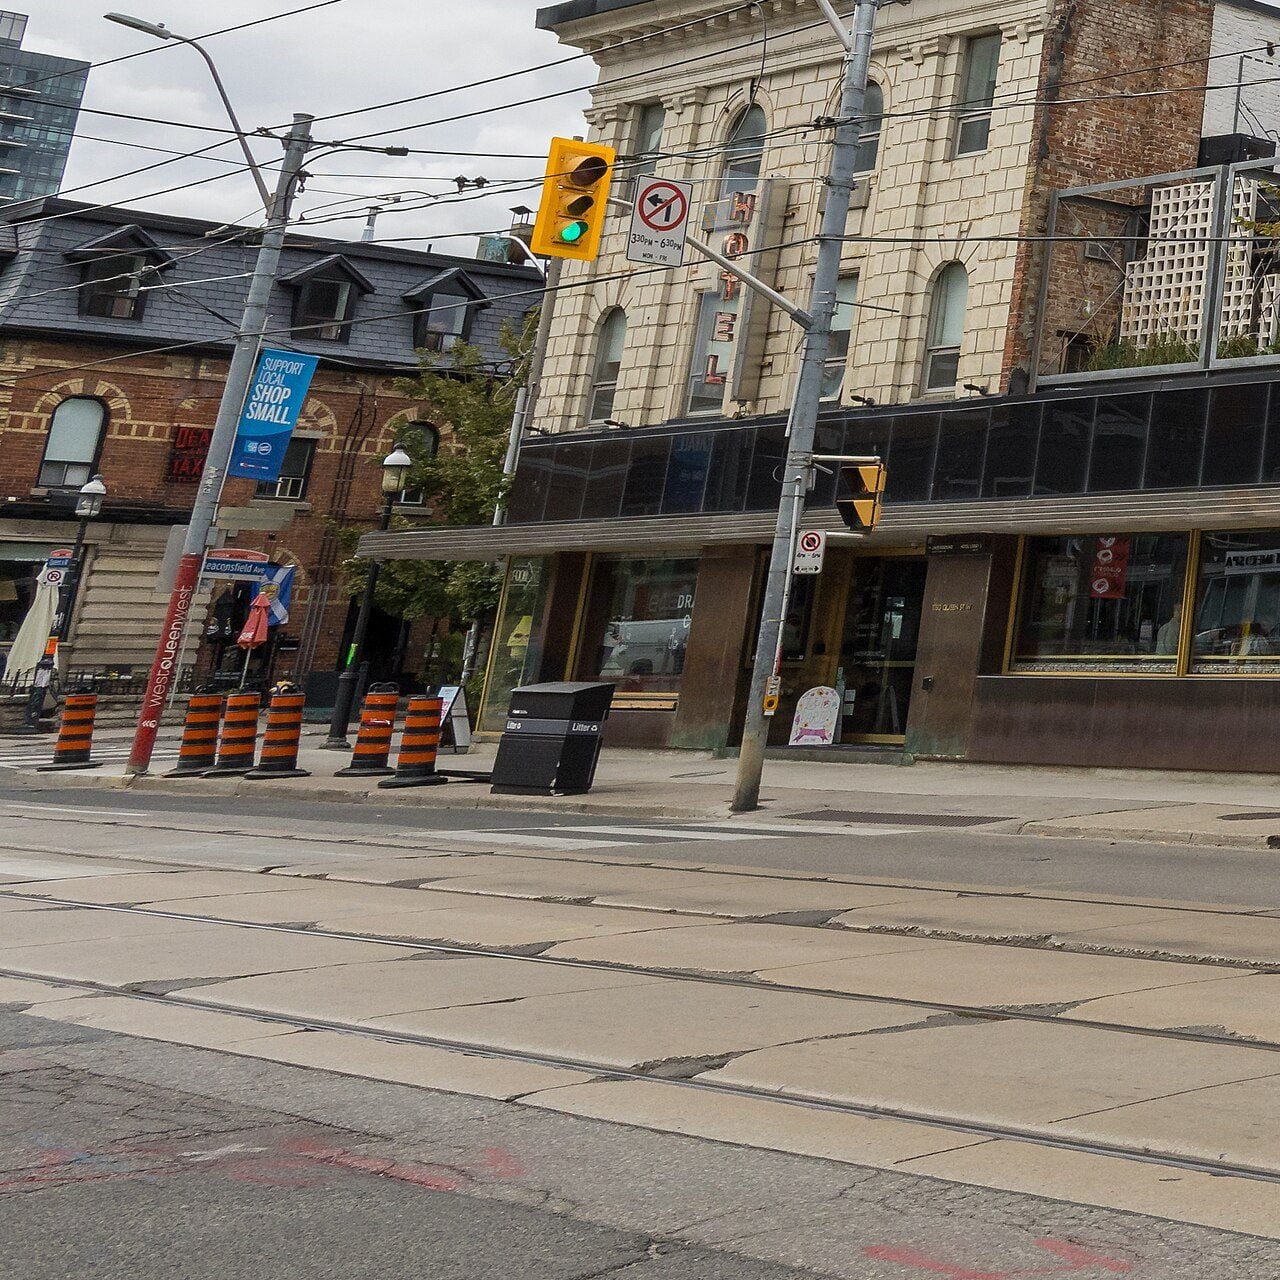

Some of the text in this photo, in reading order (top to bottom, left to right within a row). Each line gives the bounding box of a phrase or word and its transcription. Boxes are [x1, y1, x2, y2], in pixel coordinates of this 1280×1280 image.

[704, 191, 757, 385] HOTEL
[262, 357, 305, 376] SUPPORT
[257, 370, 286, 387] LOCAL
[252, 383, 291, 405] SHOP
[245, 401, 291, 425] SMALL.
[205, 561, 266, 574] eaconsfield Ave
[572, 722, 590, 732] Litter
